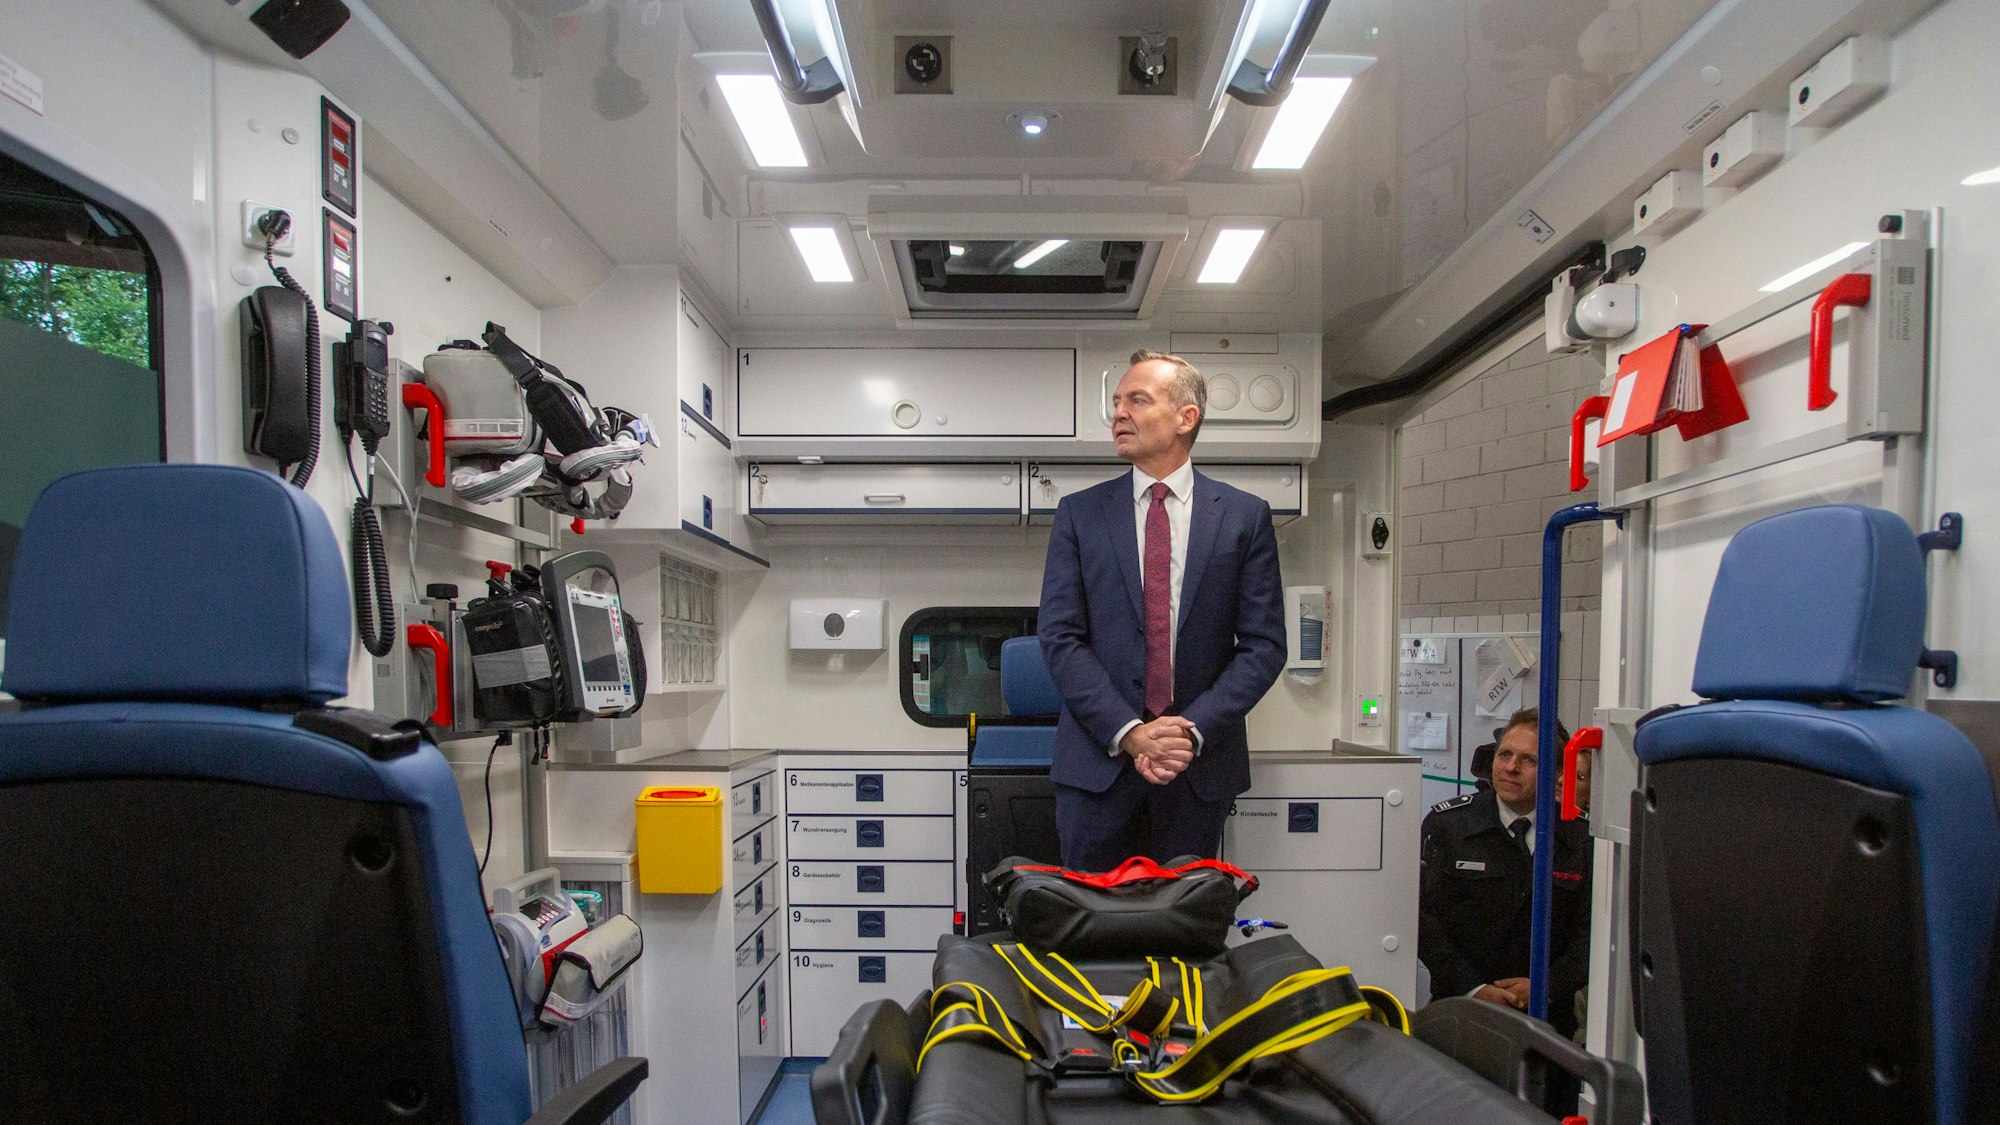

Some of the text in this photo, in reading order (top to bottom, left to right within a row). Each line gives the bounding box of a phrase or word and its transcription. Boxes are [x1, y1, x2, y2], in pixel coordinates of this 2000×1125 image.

[743, 353, 749, 366] 1
[751, 466, 760, 478] 2
[1031, 465, 1039, 478] 2
[1401, 648, 1418, 658] RTW
[1488, 677, 1508, 701] RTW
[790, 774, 797, 787] 6
[959, 775, 968, 787] 5
[791, 820, 799, 832] 7
[792, 865, 800, 877] 8
[793, 910, 801, 922] 9
[793, 955, 810, 968] 10
